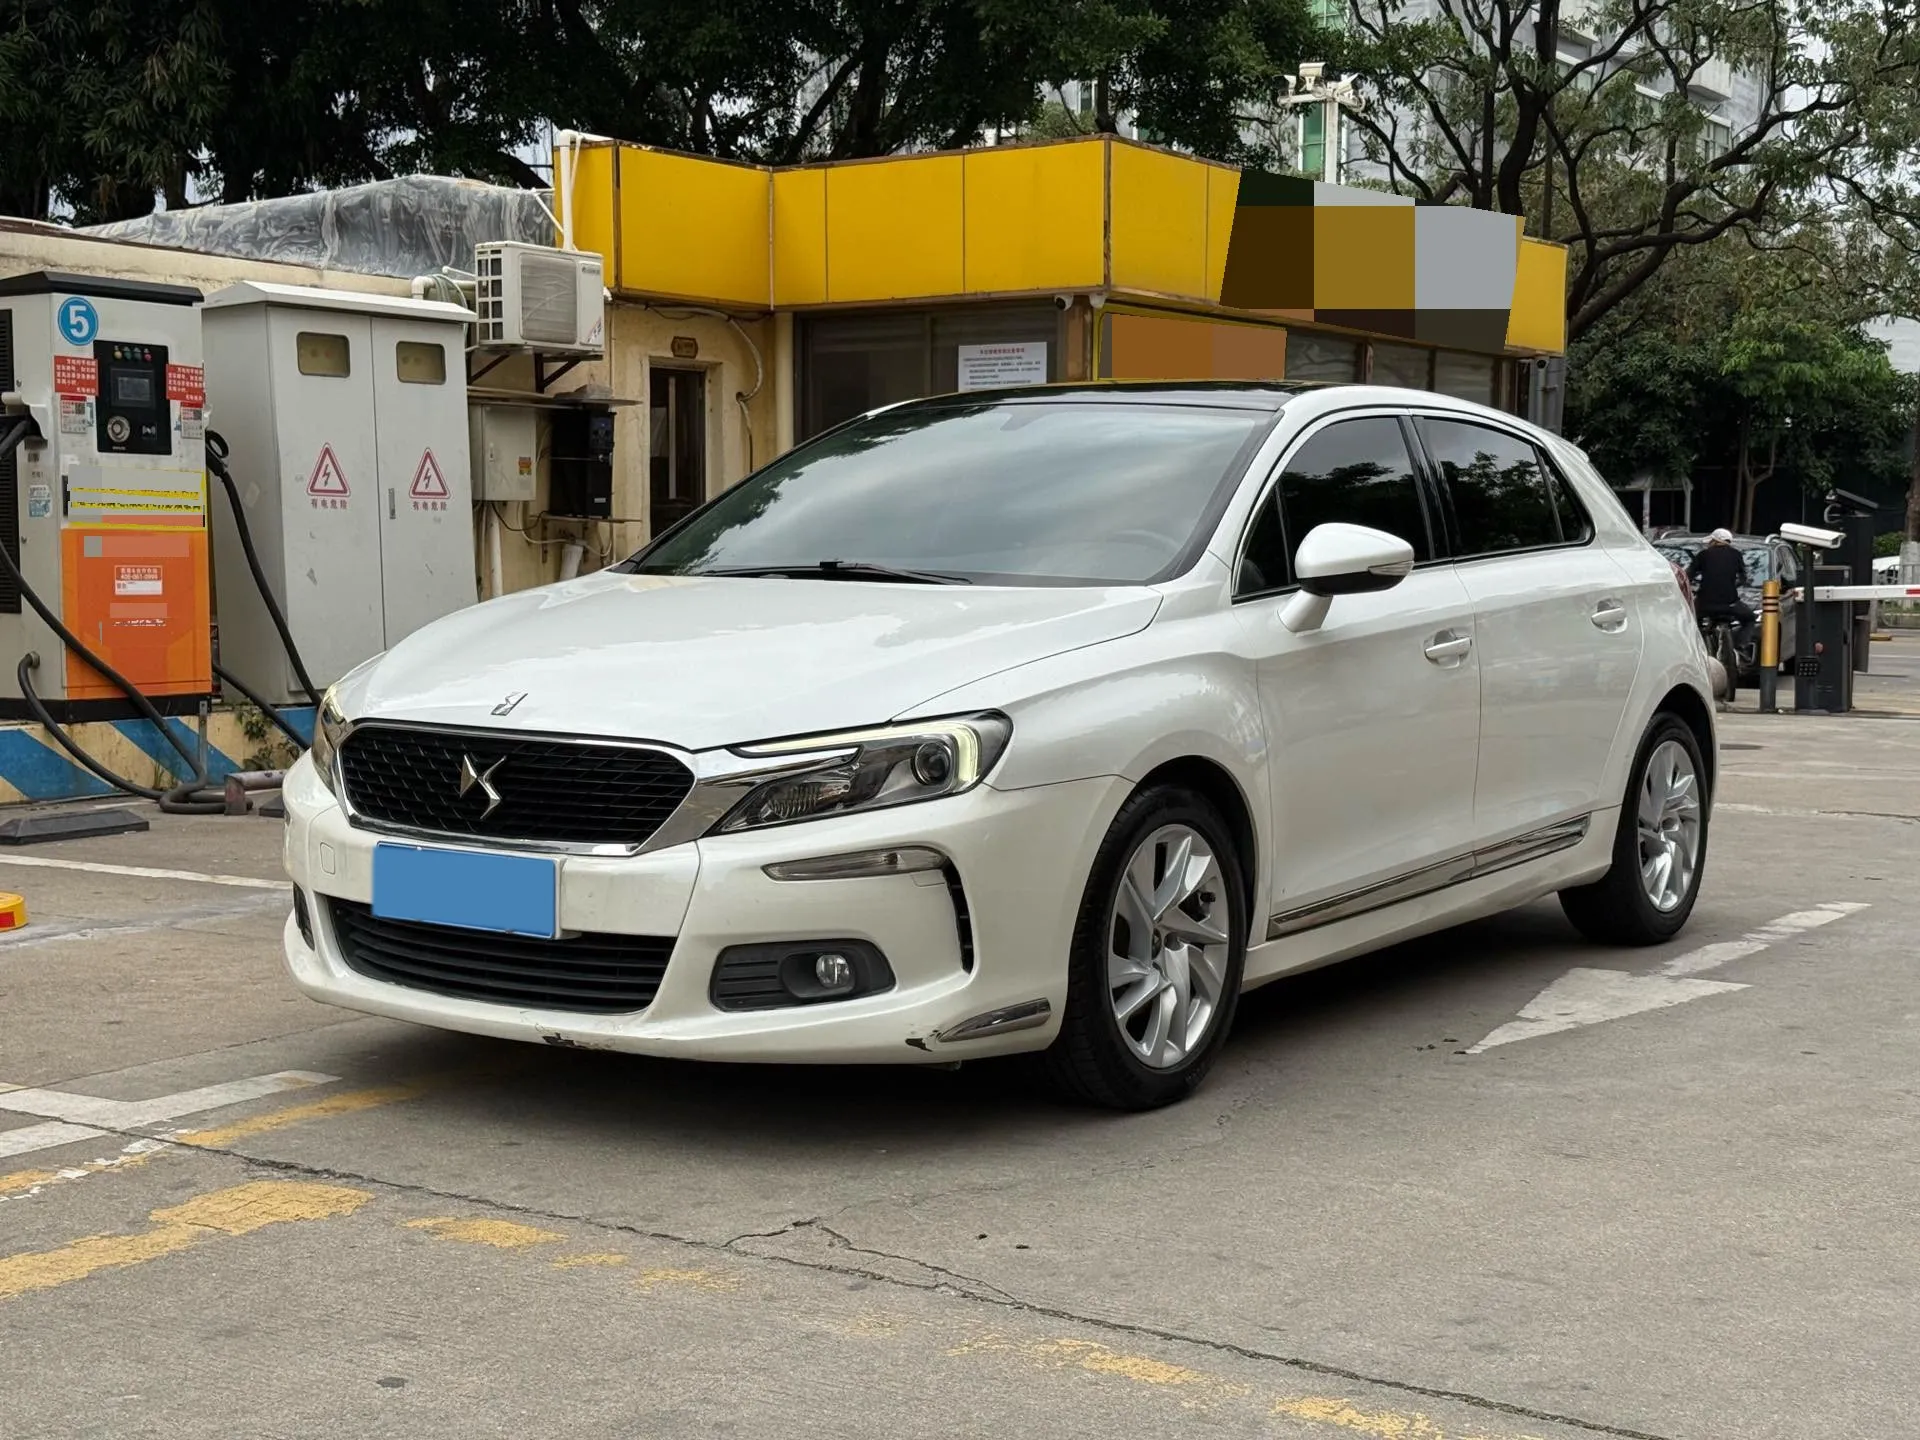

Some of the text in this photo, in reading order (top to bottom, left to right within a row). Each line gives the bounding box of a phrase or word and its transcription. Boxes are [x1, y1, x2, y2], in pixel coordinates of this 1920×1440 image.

[69, 305, 89, 338] 5
[311, 498, 348, 510] 有电危险
[412, 501, 448, 512] 有电危险
